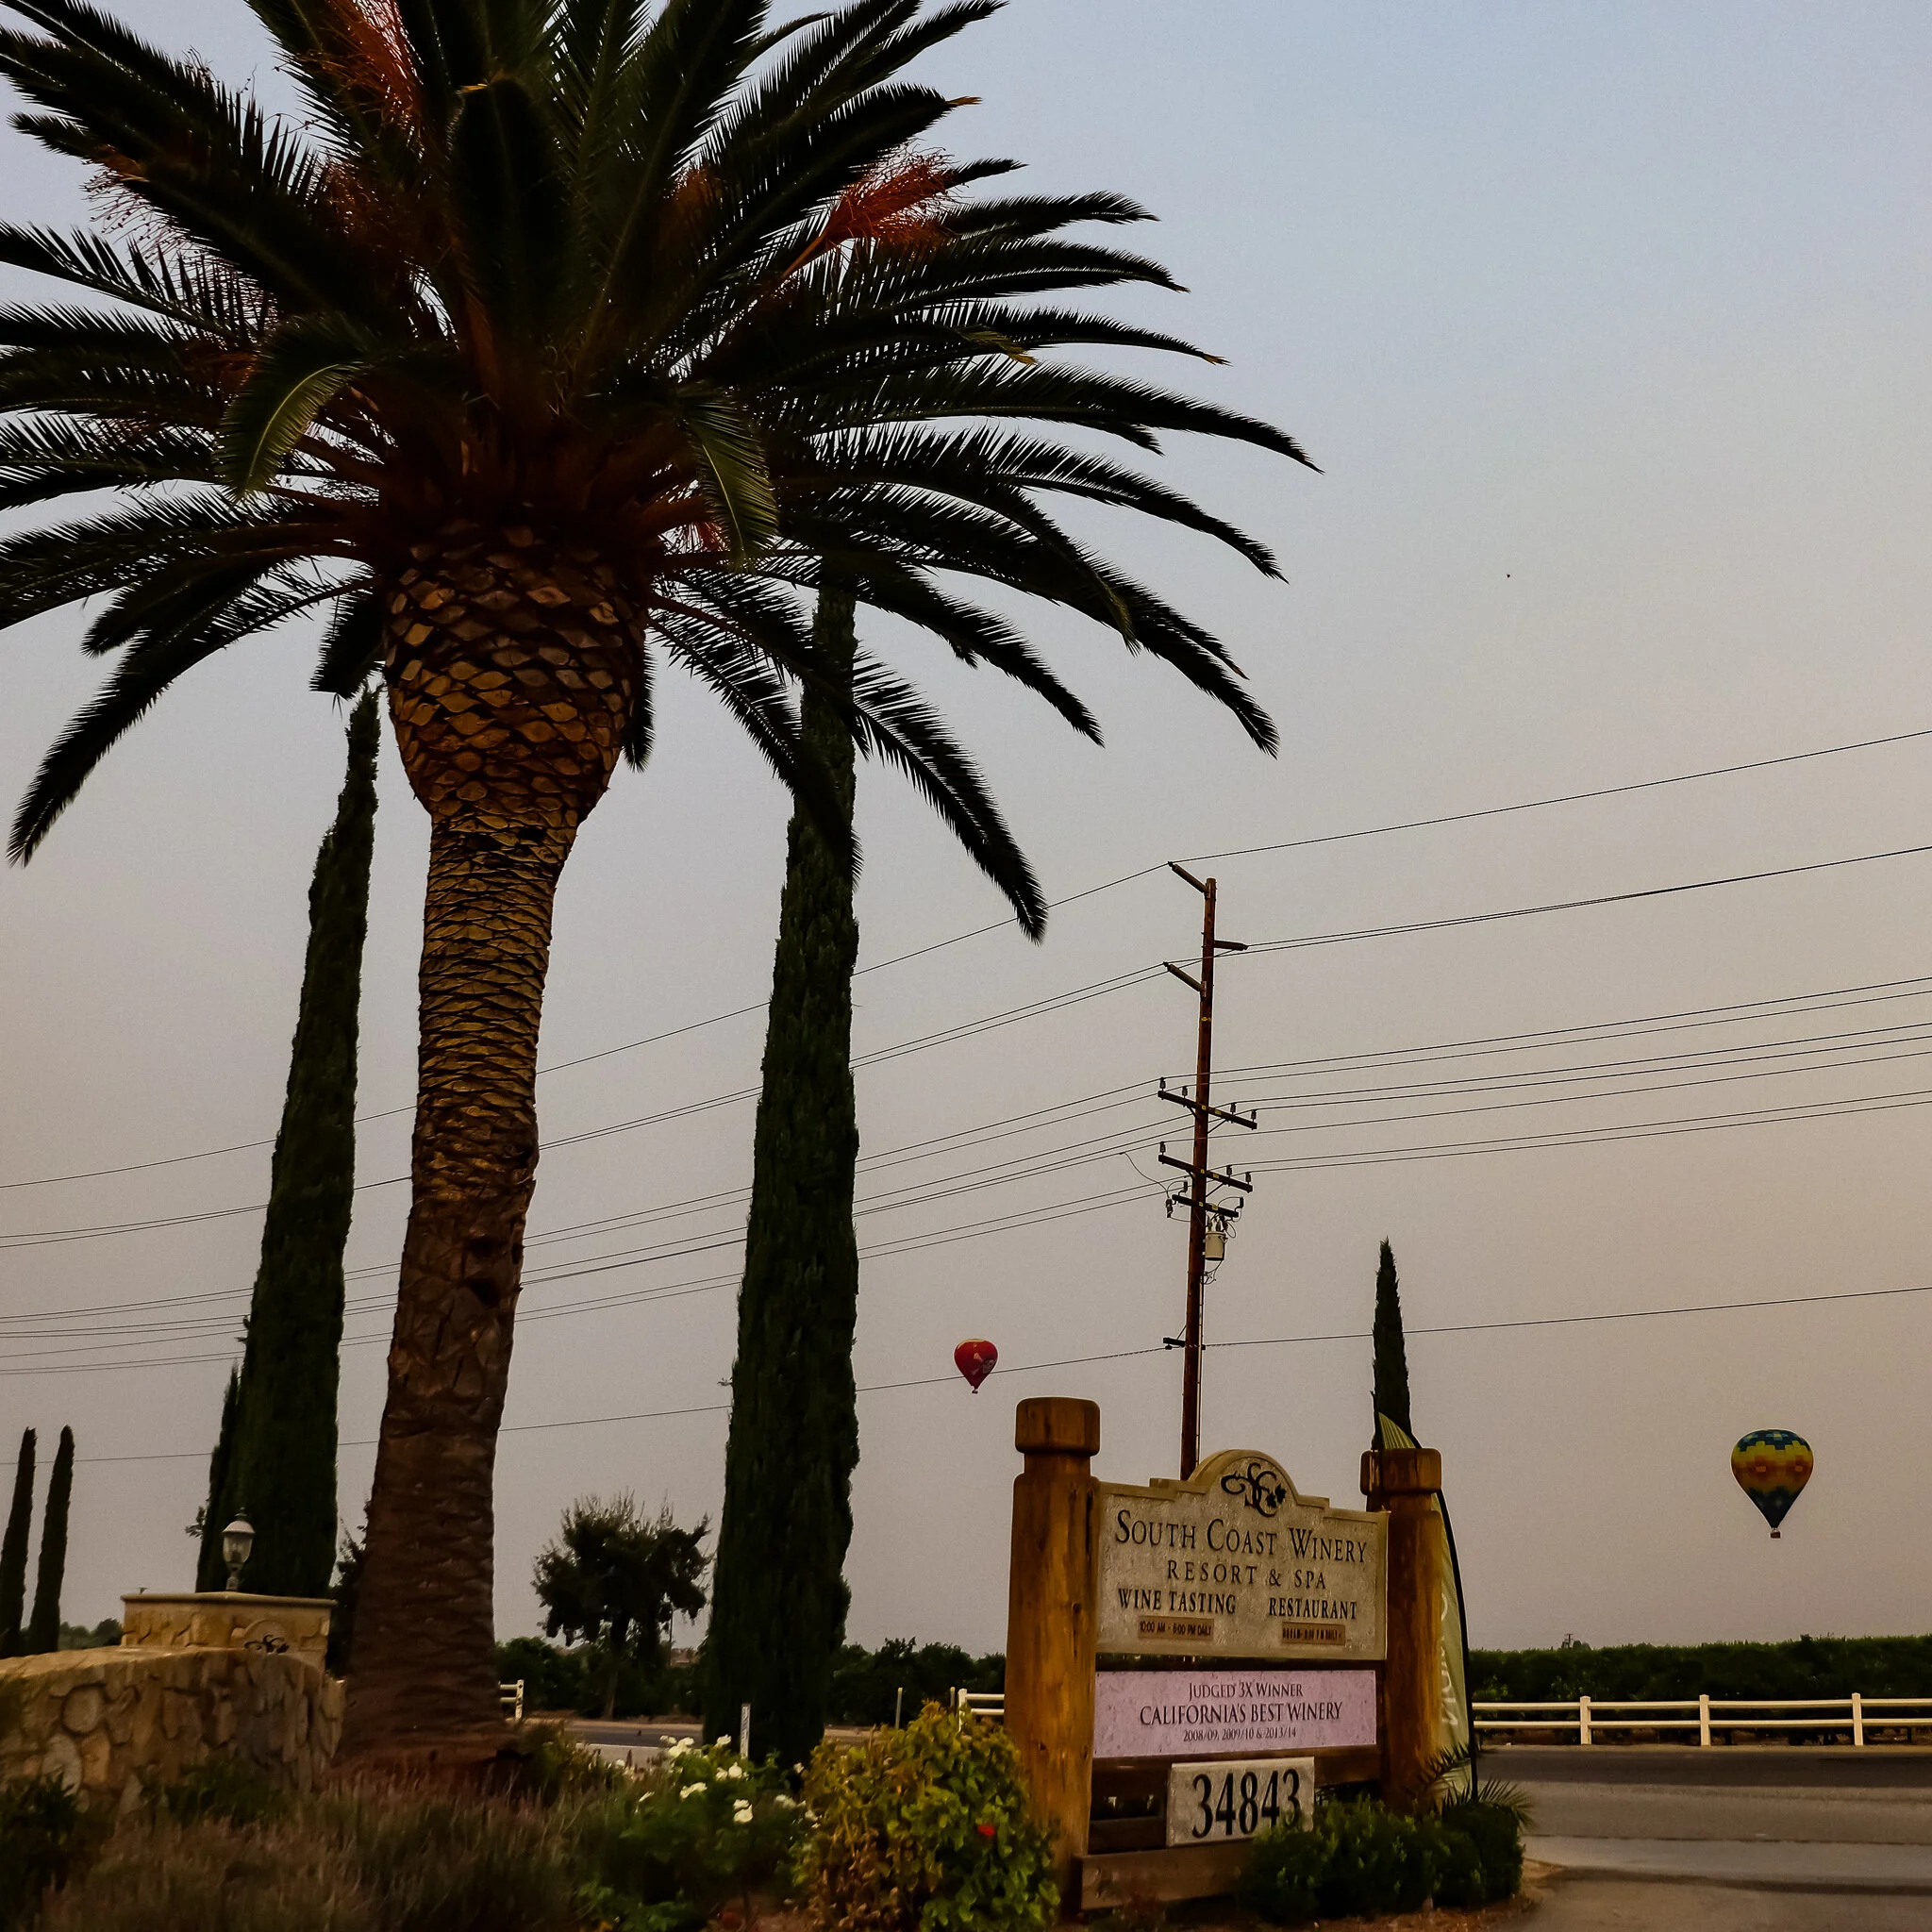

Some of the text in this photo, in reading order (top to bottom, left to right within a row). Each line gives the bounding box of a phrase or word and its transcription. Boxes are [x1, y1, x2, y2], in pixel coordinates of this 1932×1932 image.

[1115, 1509, 1367, 1563] SOUTH COAST WINERY
[1167, 1559, 1326, 1590] RESORT & SPA
[1118, 1588, 1236, 1615] WINE TASTING
[1269, 1597, 1357, 1620] RESTAURANT
[1157, 1622, 1166, 1633] AM
[1188, 1624, 1196, 1635] PM
[1189, 1681, 1304, 1702] JUDGED 3X WINNER
[1140, 1701, 1342, 1725] CALIFORNIA'S BEST WINERY
[1221, 1727, 1255, 1740] 2009/10
[1256, 1729, 1263, 1740] &
[1264, 1725, 1297, 1740] 2013/14
[1191, 1768, 1302, 1839] 34843
